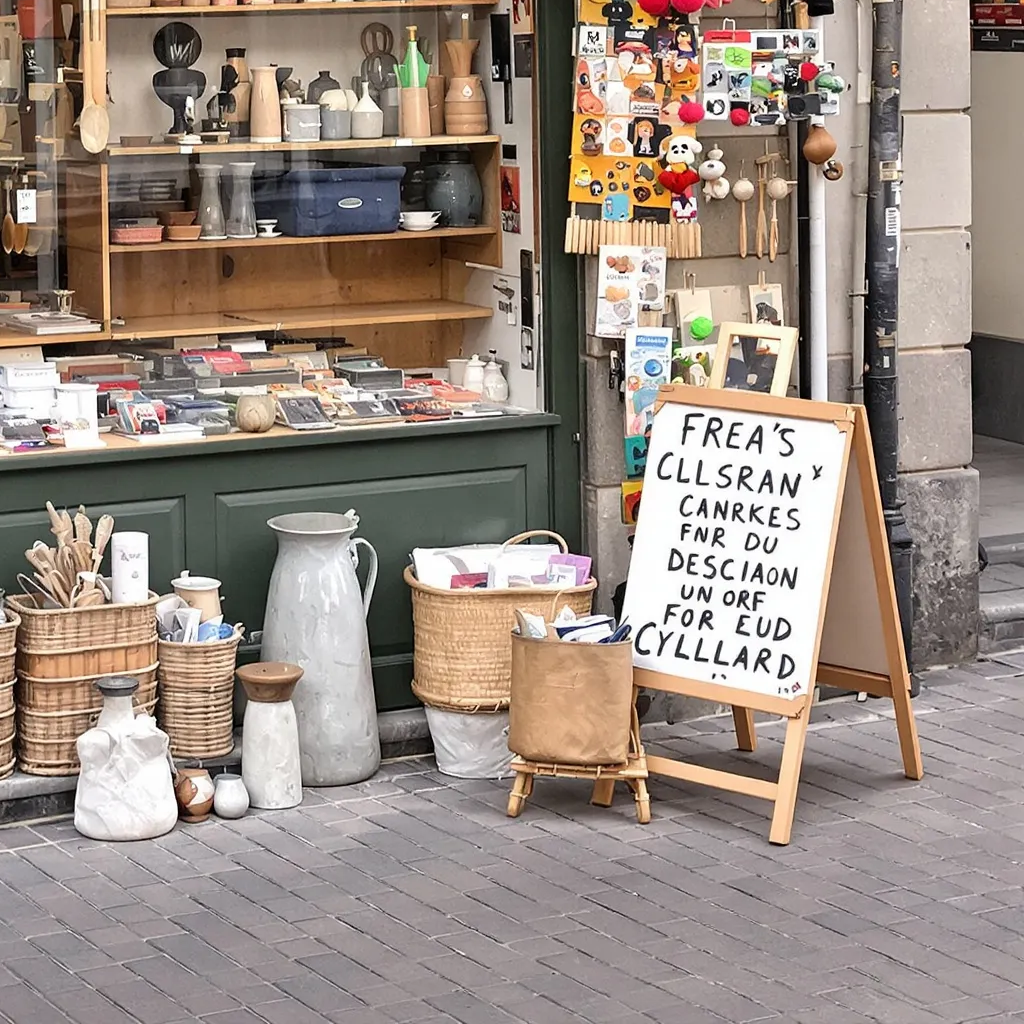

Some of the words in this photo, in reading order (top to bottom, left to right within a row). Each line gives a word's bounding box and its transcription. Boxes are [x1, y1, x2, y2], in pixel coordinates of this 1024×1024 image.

[681, 413, 796, 458] FREA'S
[679, 495, 801, 531] CANRKES
[680, 523, 726, 549] FNR
[744, 532, 779, 555] DU
[667, 548, 798, 590] DESCIAON
[680, 583, 713, 606] UN
[722, 588, 767, 613] ORF
[663, 603, 714, 632] FOR
[735, 613, 793, 642] EUD
[634, 621, 796, 680] CYLLLARD
